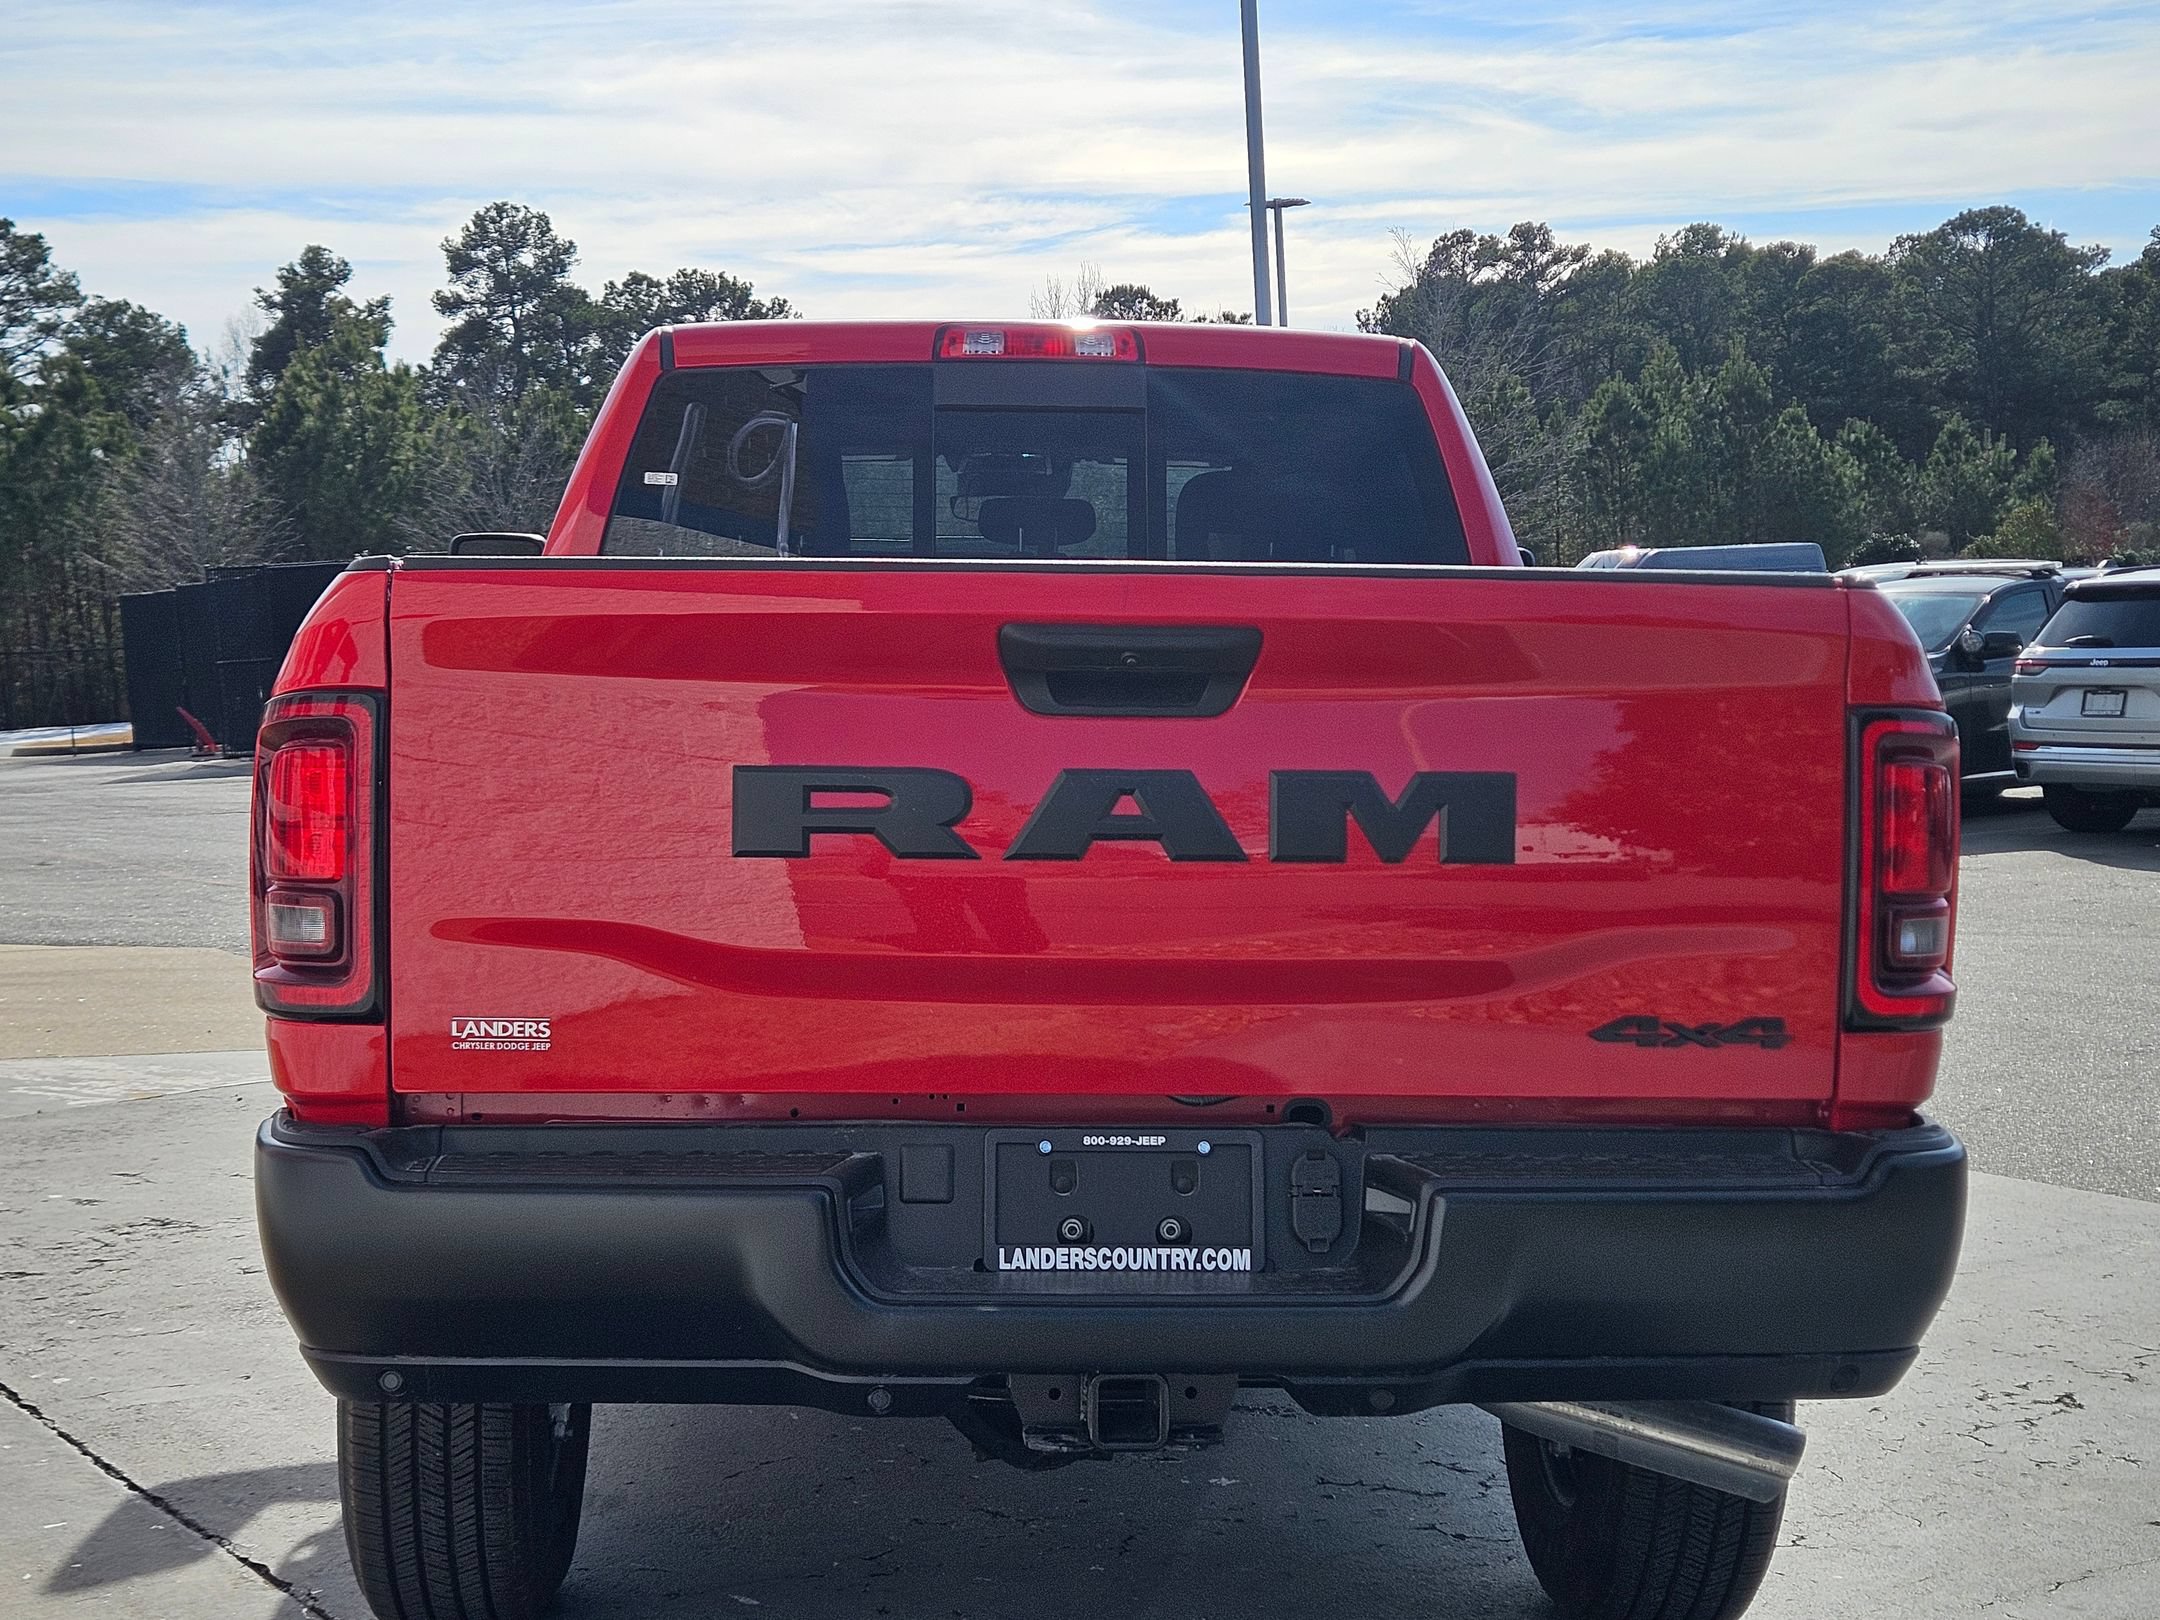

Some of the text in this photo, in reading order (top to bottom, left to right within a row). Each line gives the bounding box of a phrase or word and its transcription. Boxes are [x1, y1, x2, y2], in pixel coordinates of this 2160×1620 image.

[2090, 658, 2109, 666] Jeep
[732, 765, 1517, 865] RAM
[451, 1021, 551, 1038] LANDERS
[452, 1041, 551, 1051] CHRYSLER DODGE JEEP
[1083, 1136, 1166, 1146] 800-929-JEEP
[999, 1247, 1251, 1271] LANDERSCOUNTRY.COM
